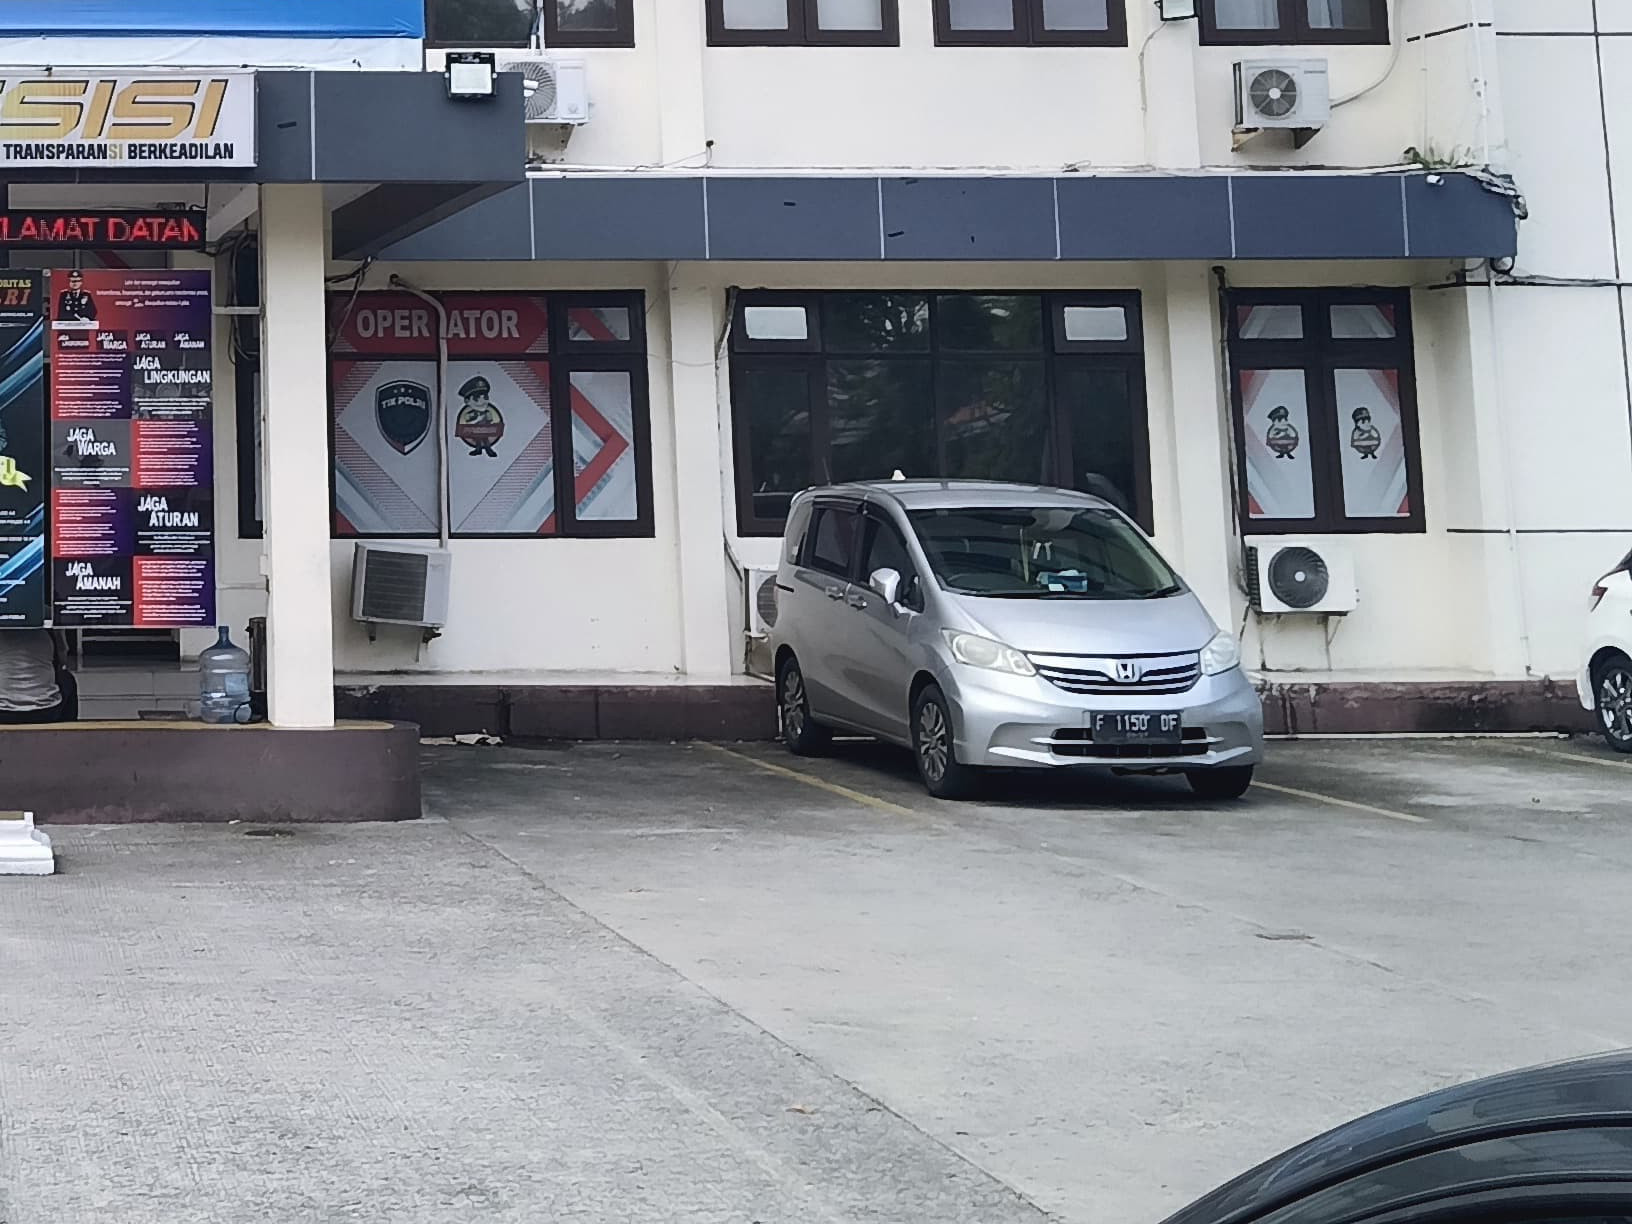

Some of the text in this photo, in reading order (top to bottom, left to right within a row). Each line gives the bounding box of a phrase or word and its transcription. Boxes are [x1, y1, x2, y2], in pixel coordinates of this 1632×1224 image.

[3, 143, 123, 160] TRANSPARANSI
[128, 142, 234, 160] BERKEADILAN
[356, 308, 520, 339] OPERATOR
[133, 354, 161, 370] JAGA
[144, 370, 211, 384] LINGKUNGAN
[67, 427, 94, 442] JAGA
[77, 441, 116, 456] WARGA
[137, 494, 168, 512] JAGA
[149, 511, 199, 527] ATURAN
[65, 561, 94, 577] JAGA
[76, 575, 121, 590] AMANAH
[1096, 714, 1105, 731] F
